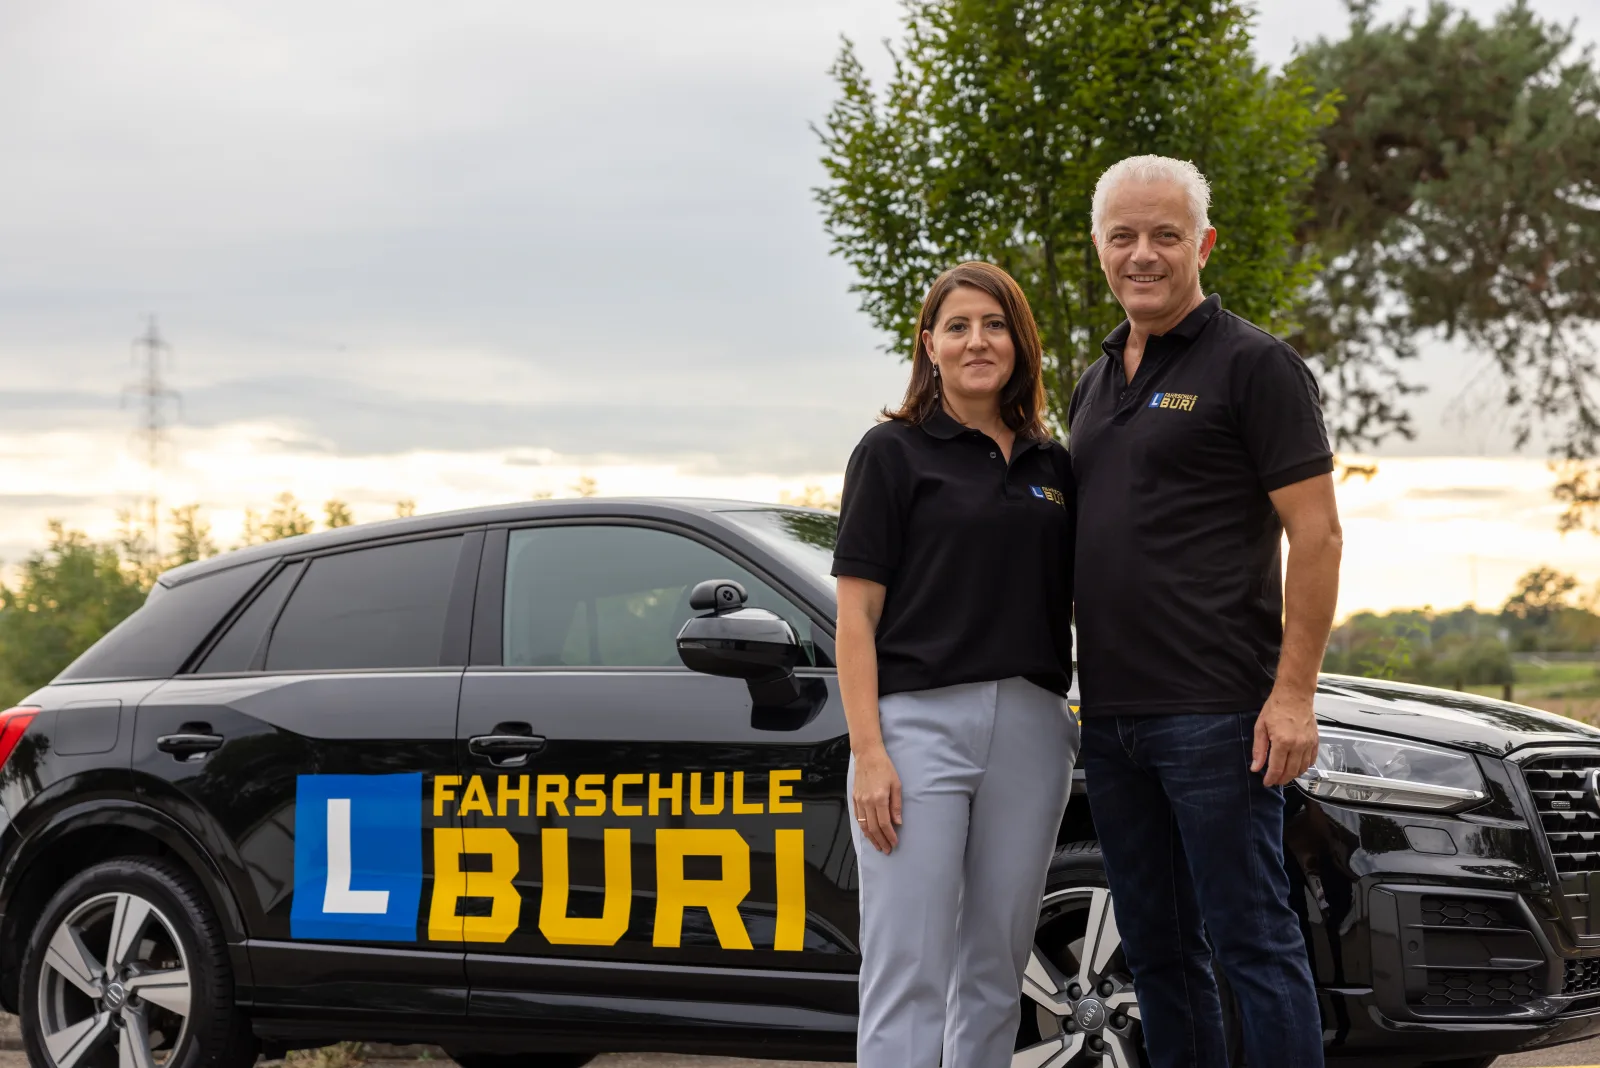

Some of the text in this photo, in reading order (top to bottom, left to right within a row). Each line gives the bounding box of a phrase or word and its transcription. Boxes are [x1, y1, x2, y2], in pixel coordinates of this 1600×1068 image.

[1160, 397, 1195, 411] BURI
[1031, 486, 1044, 498] L
[433, 769, 803, 817] FAHRSCHULE
[322, 798, 390, 914] L
[428, 827, 806, 952] BURI
